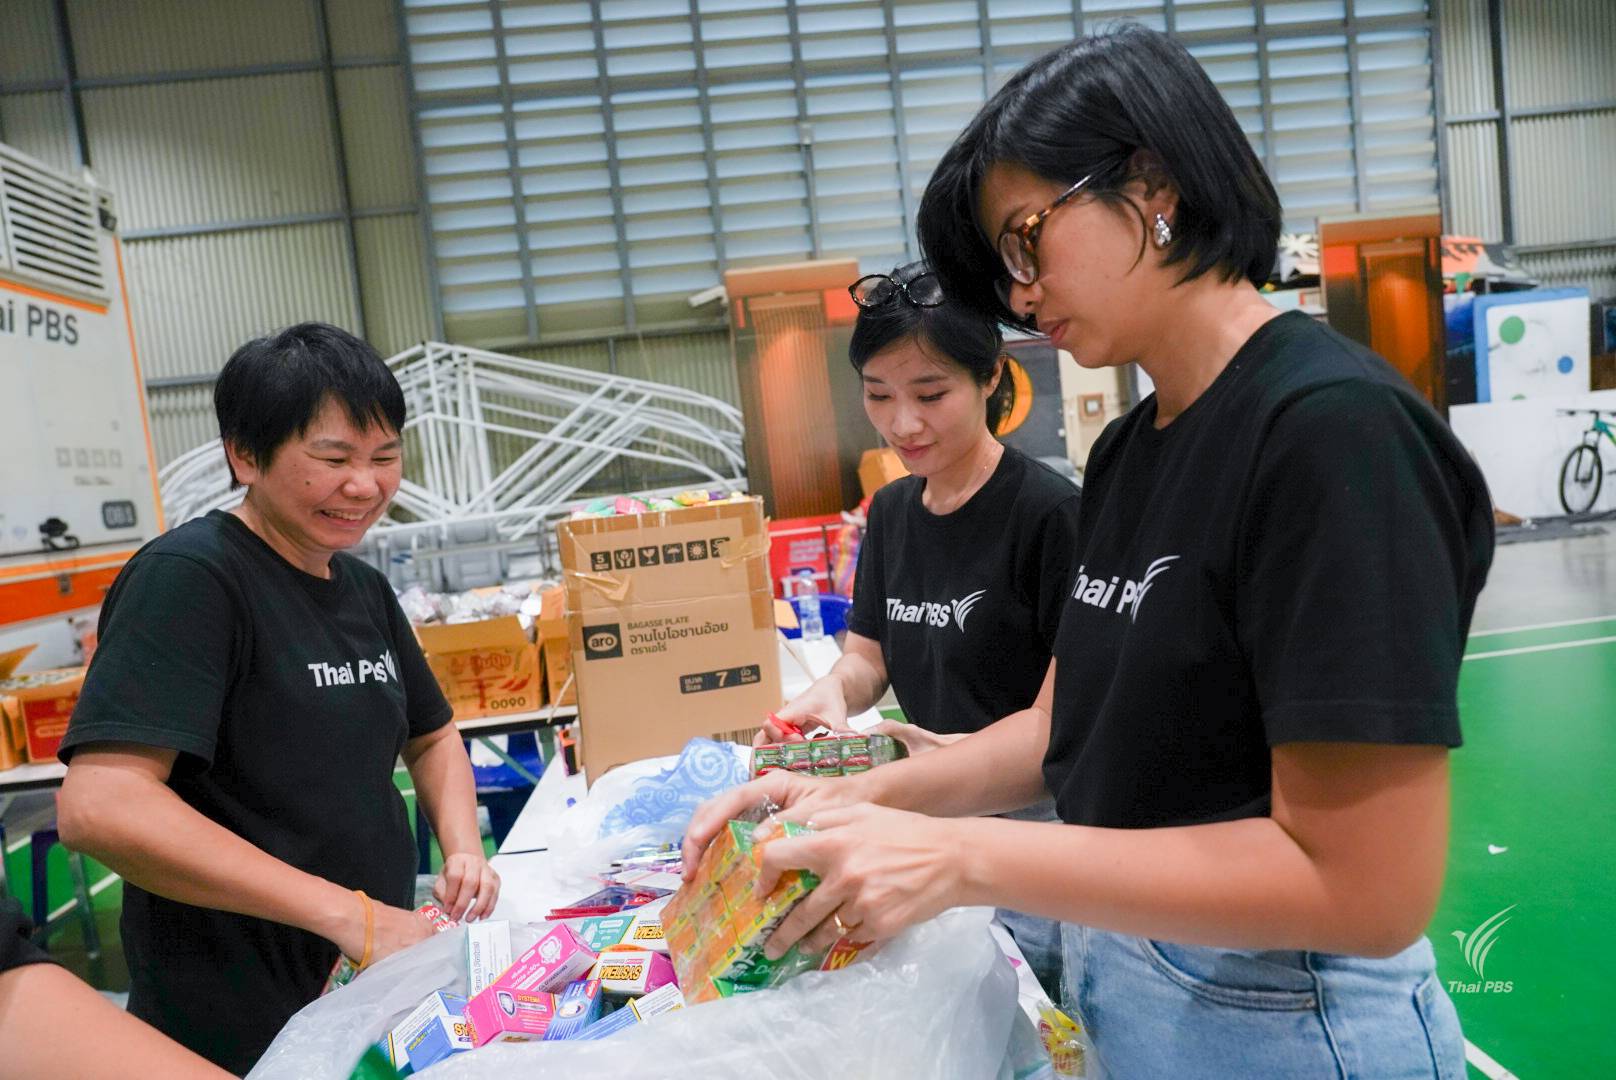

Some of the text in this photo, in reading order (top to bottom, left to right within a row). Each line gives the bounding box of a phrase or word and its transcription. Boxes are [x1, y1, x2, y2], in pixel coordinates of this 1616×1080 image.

[27, 303, 79, 345] PBS
[886, 597, 926, 623] Thai
[627, 615, 689, 630] BAGASSE PLATE
[591, 634, 615, 648] aro
[307, 661, 355, 687] Thai
[715, 671, 728, 687] 7
[600, 964, 643, 981] SYSTEMA
